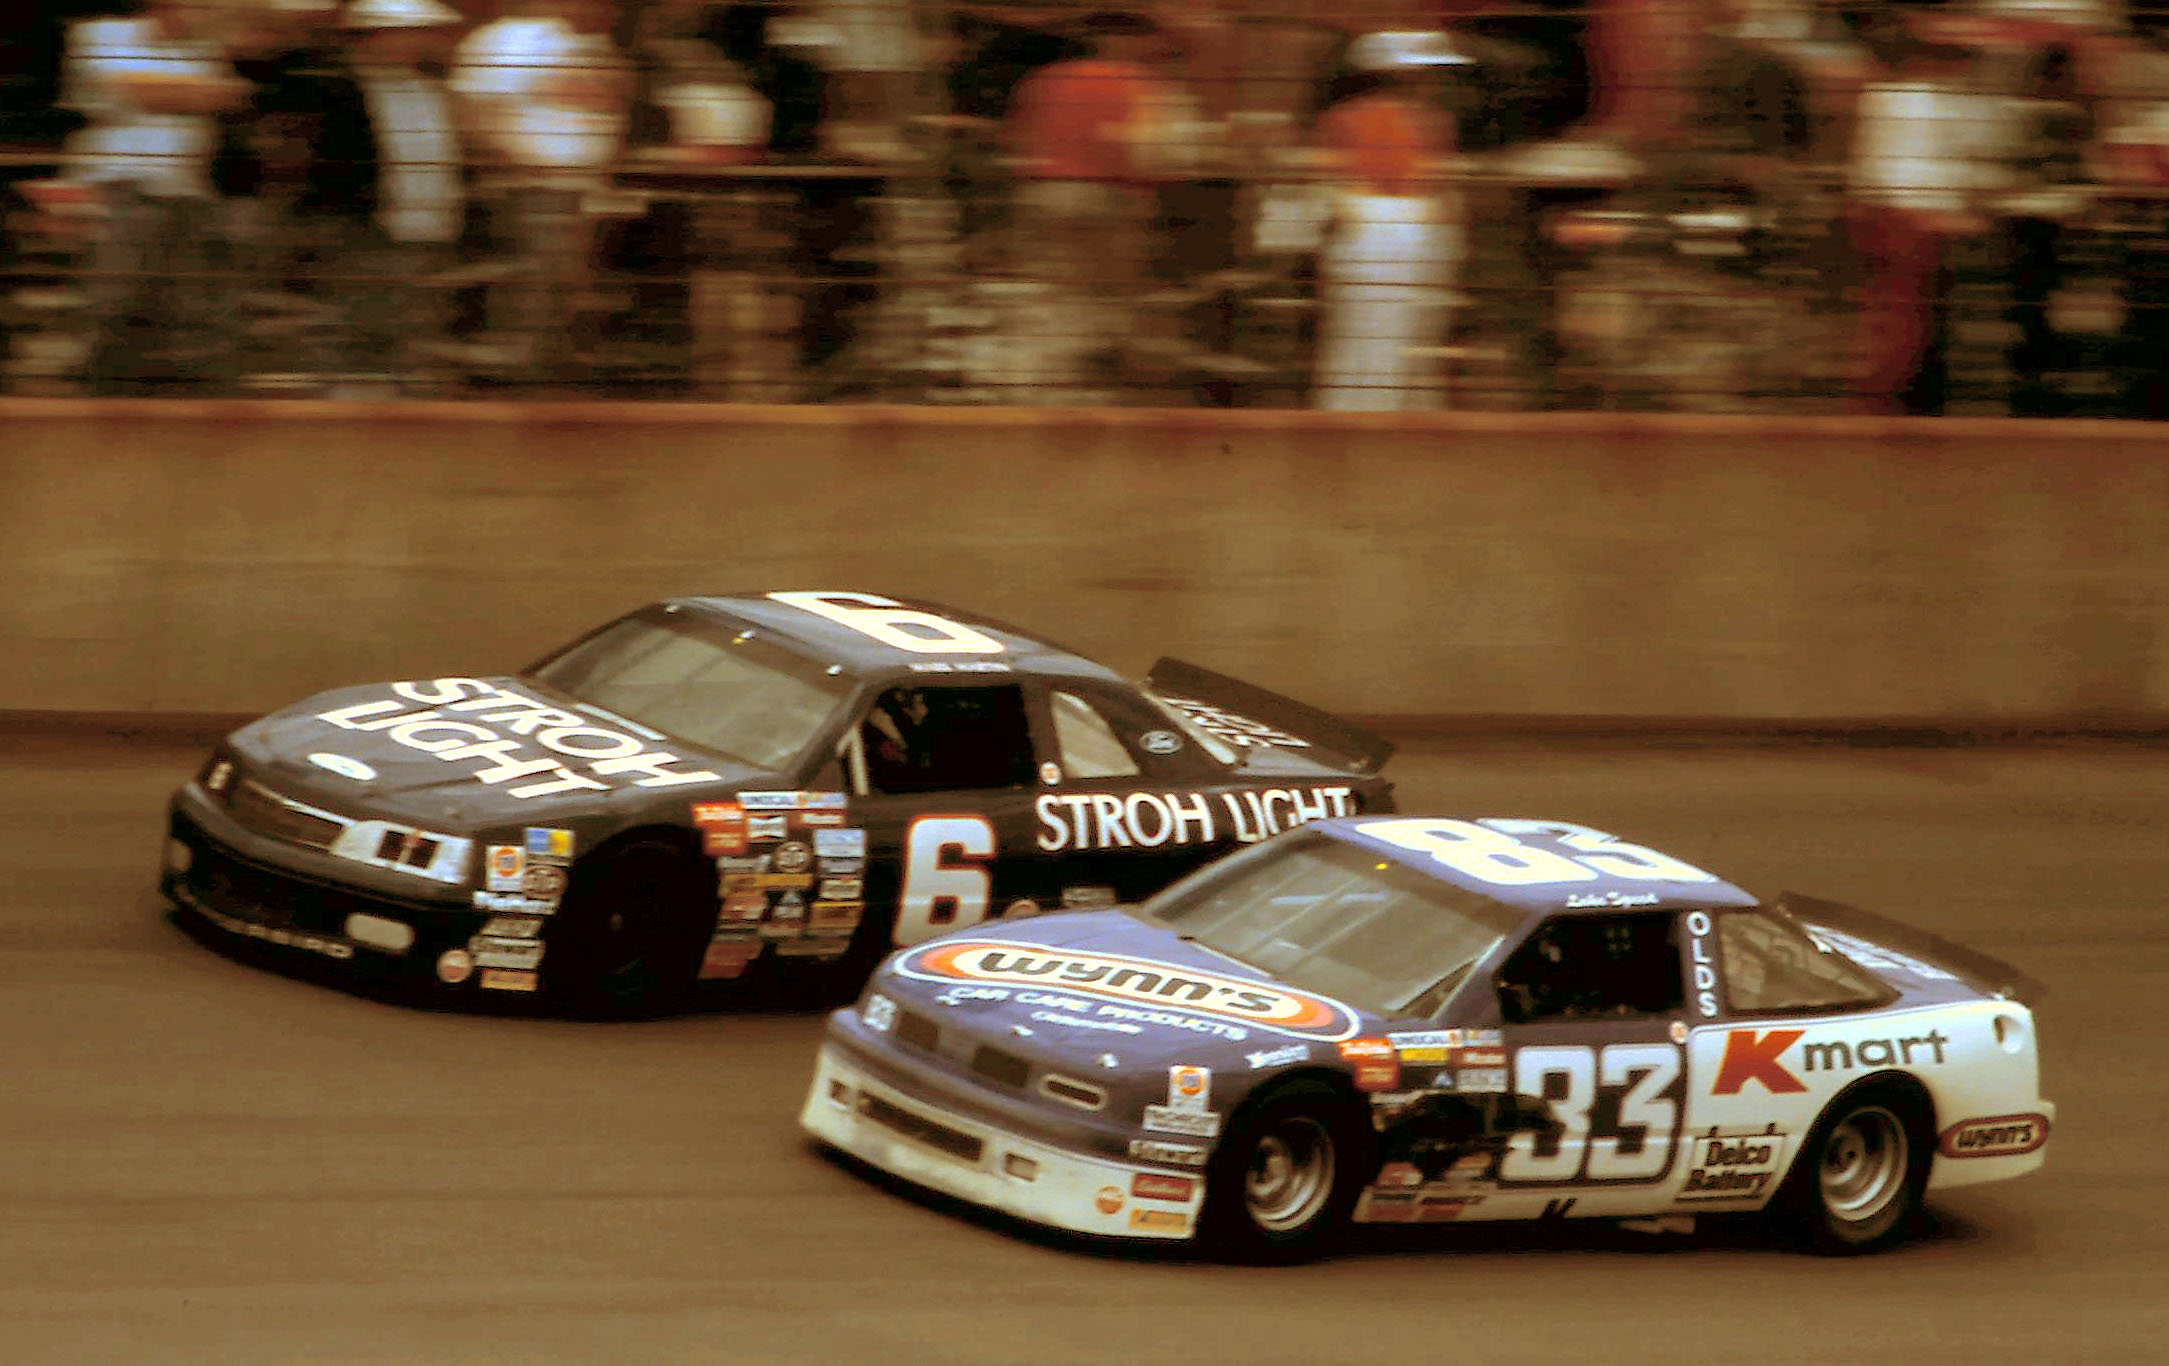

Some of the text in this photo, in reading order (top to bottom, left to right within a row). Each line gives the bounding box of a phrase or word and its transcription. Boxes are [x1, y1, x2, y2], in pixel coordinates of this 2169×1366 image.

[767, 591, 1004, 653] 6
[317, 699, 612, 798] LIGHT
[393, 677, 723, 788] STROH
[1036, 792, 1215, 851] STROH
[894, 816, 995, 949] 6
[1687, 911, 1719, 1018] OLDS
[950, 988, 1010, 1002] CAR
[1097, 1005, 1248, 1041] PRODUCTS
